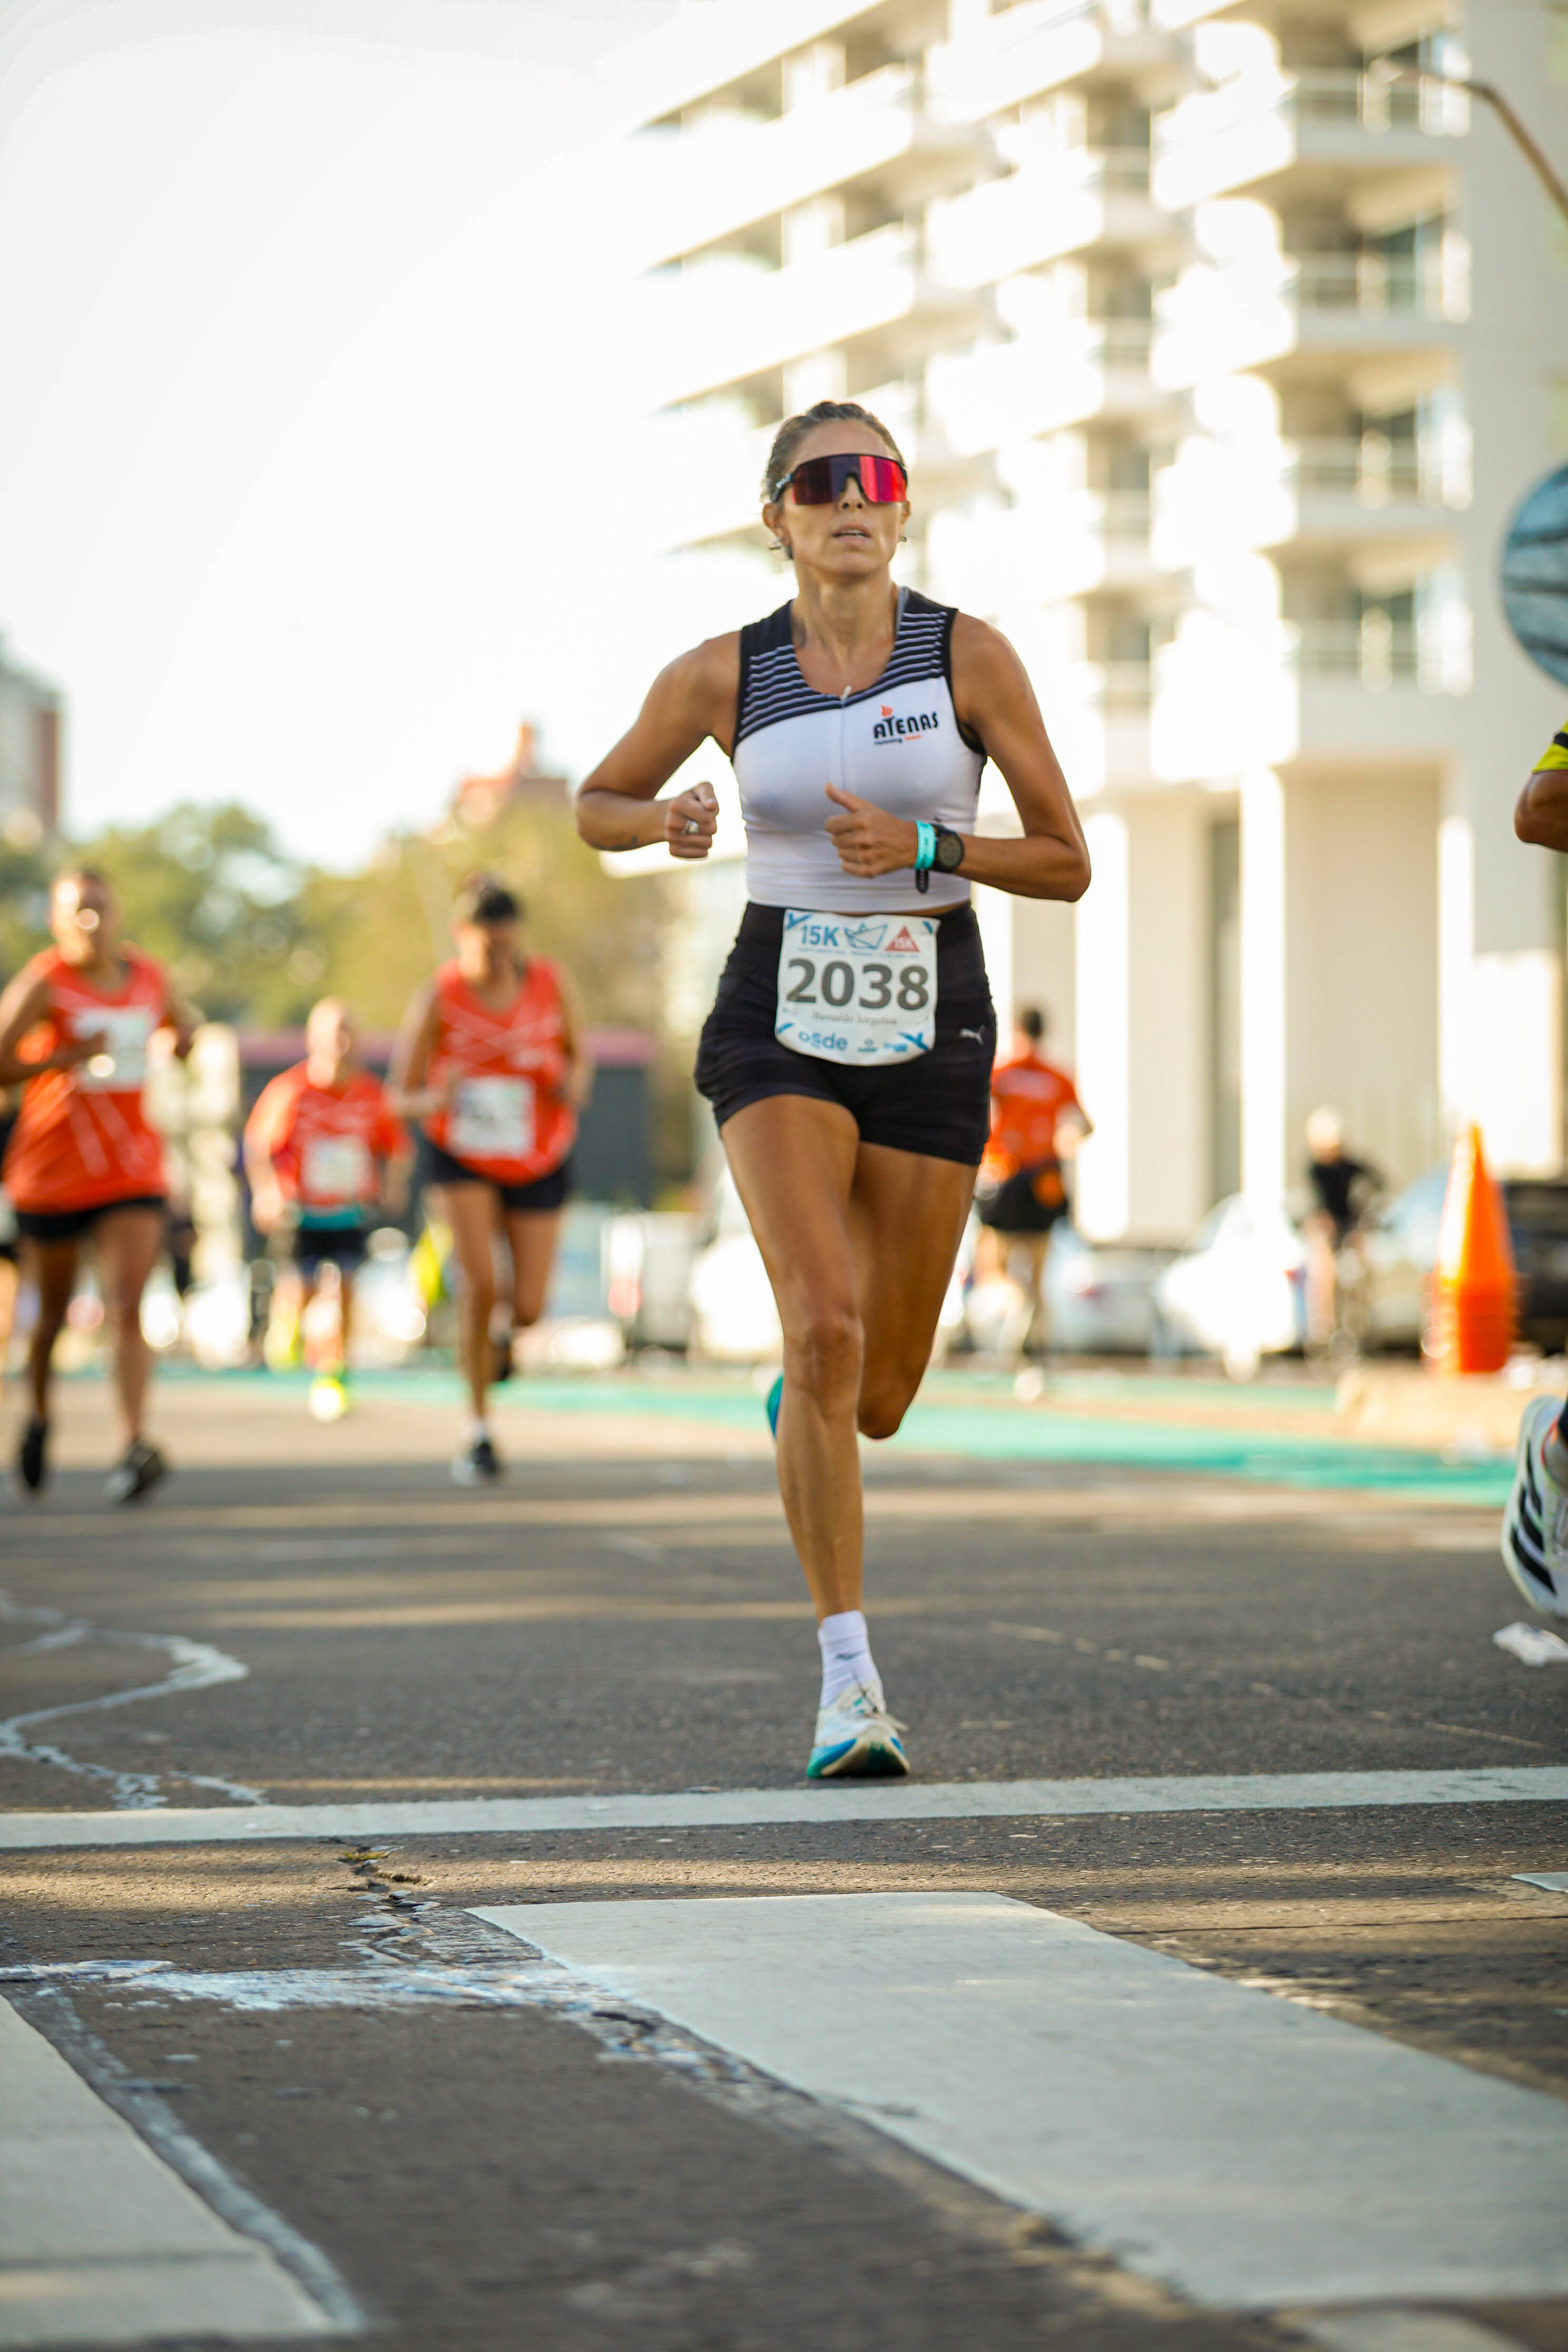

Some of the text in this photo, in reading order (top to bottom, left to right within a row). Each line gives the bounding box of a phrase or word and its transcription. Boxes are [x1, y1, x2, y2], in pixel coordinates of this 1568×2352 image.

[874, 711, 938, 738] ATENAS
[800, 925, 839, 947] 15K
[786, 957, 928, 1011] 2038
[798, 1031, 848, 1050] osde
